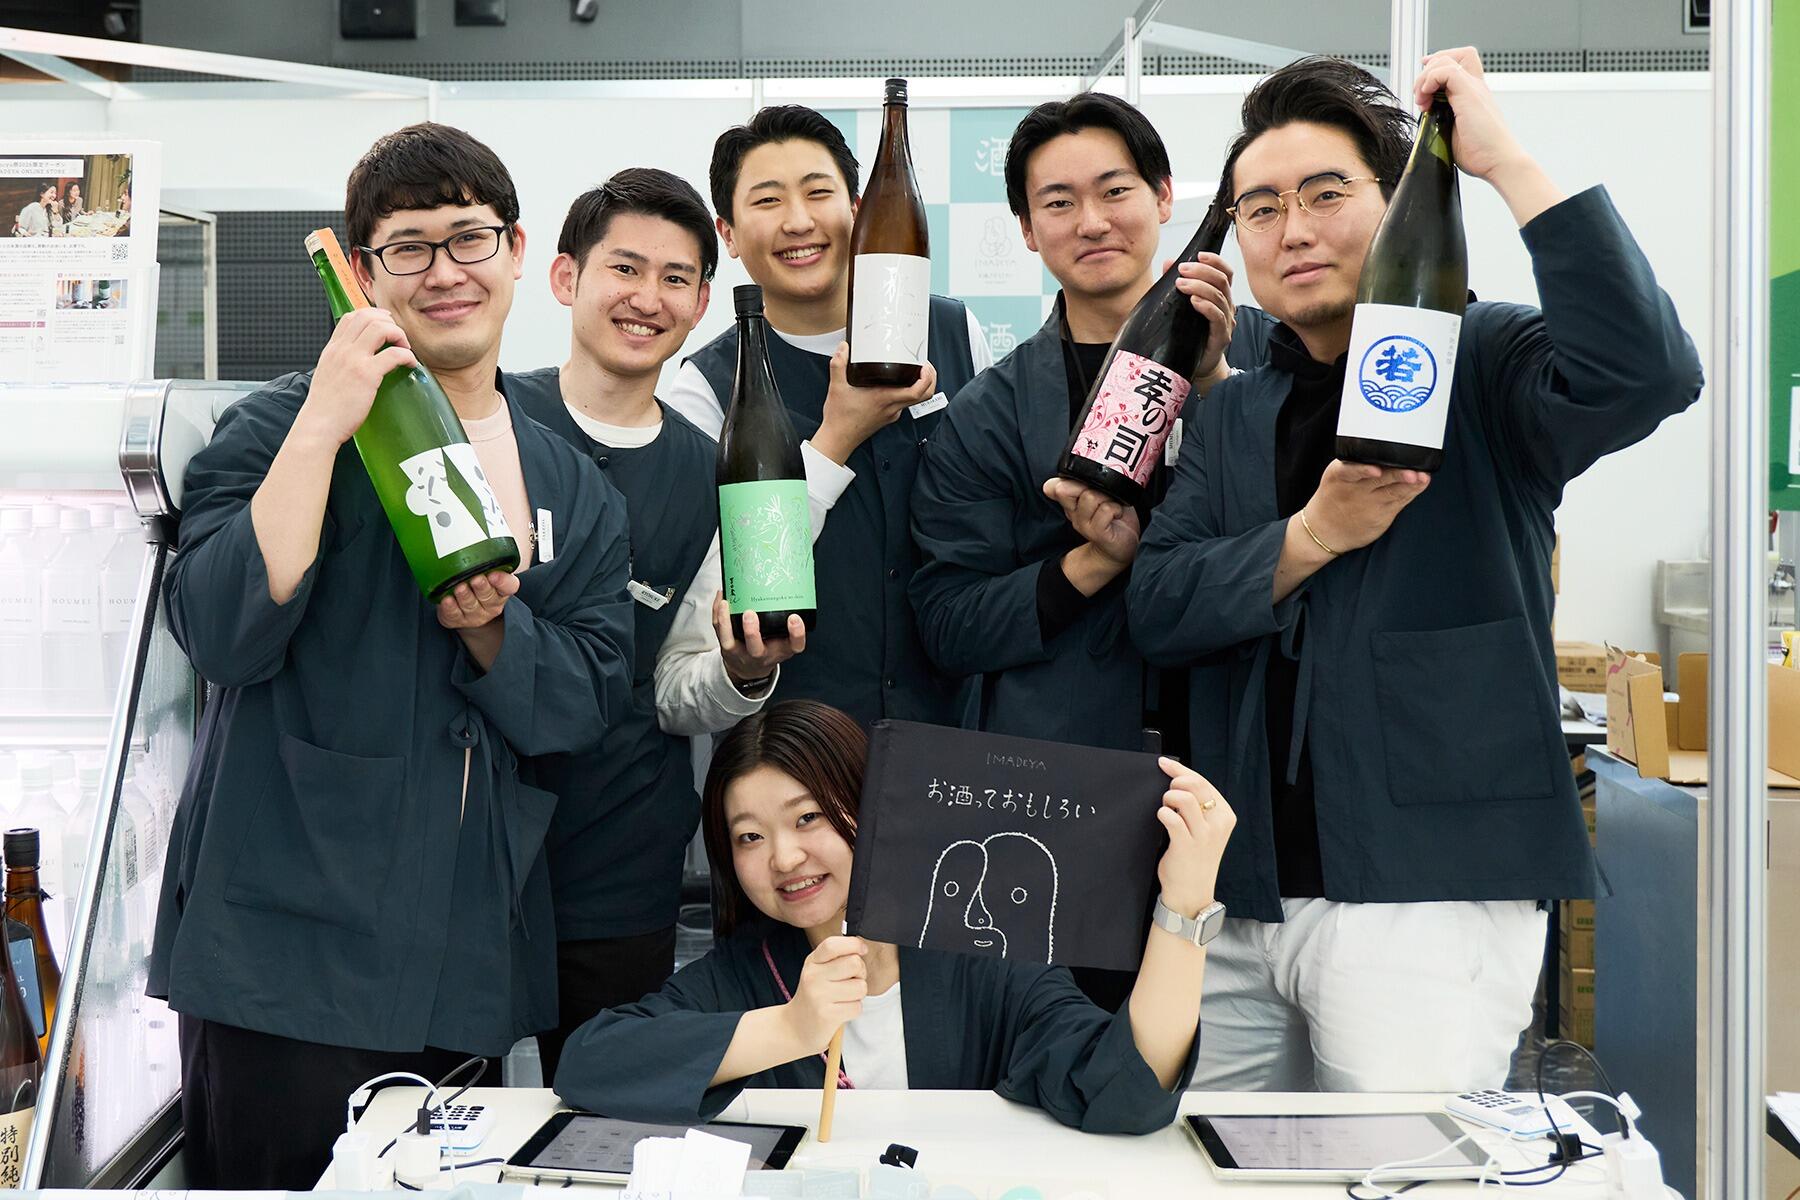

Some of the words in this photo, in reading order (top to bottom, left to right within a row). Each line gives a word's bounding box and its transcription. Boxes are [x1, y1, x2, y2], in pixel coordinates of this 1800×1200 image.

[1375, 345, 1422, 383] 若
[985, 752, 1047, 771] IMADEYA
[927, 778, 1096, 820] お酒っておもしろい
[0, 1124, 20, 1189] 特別純
